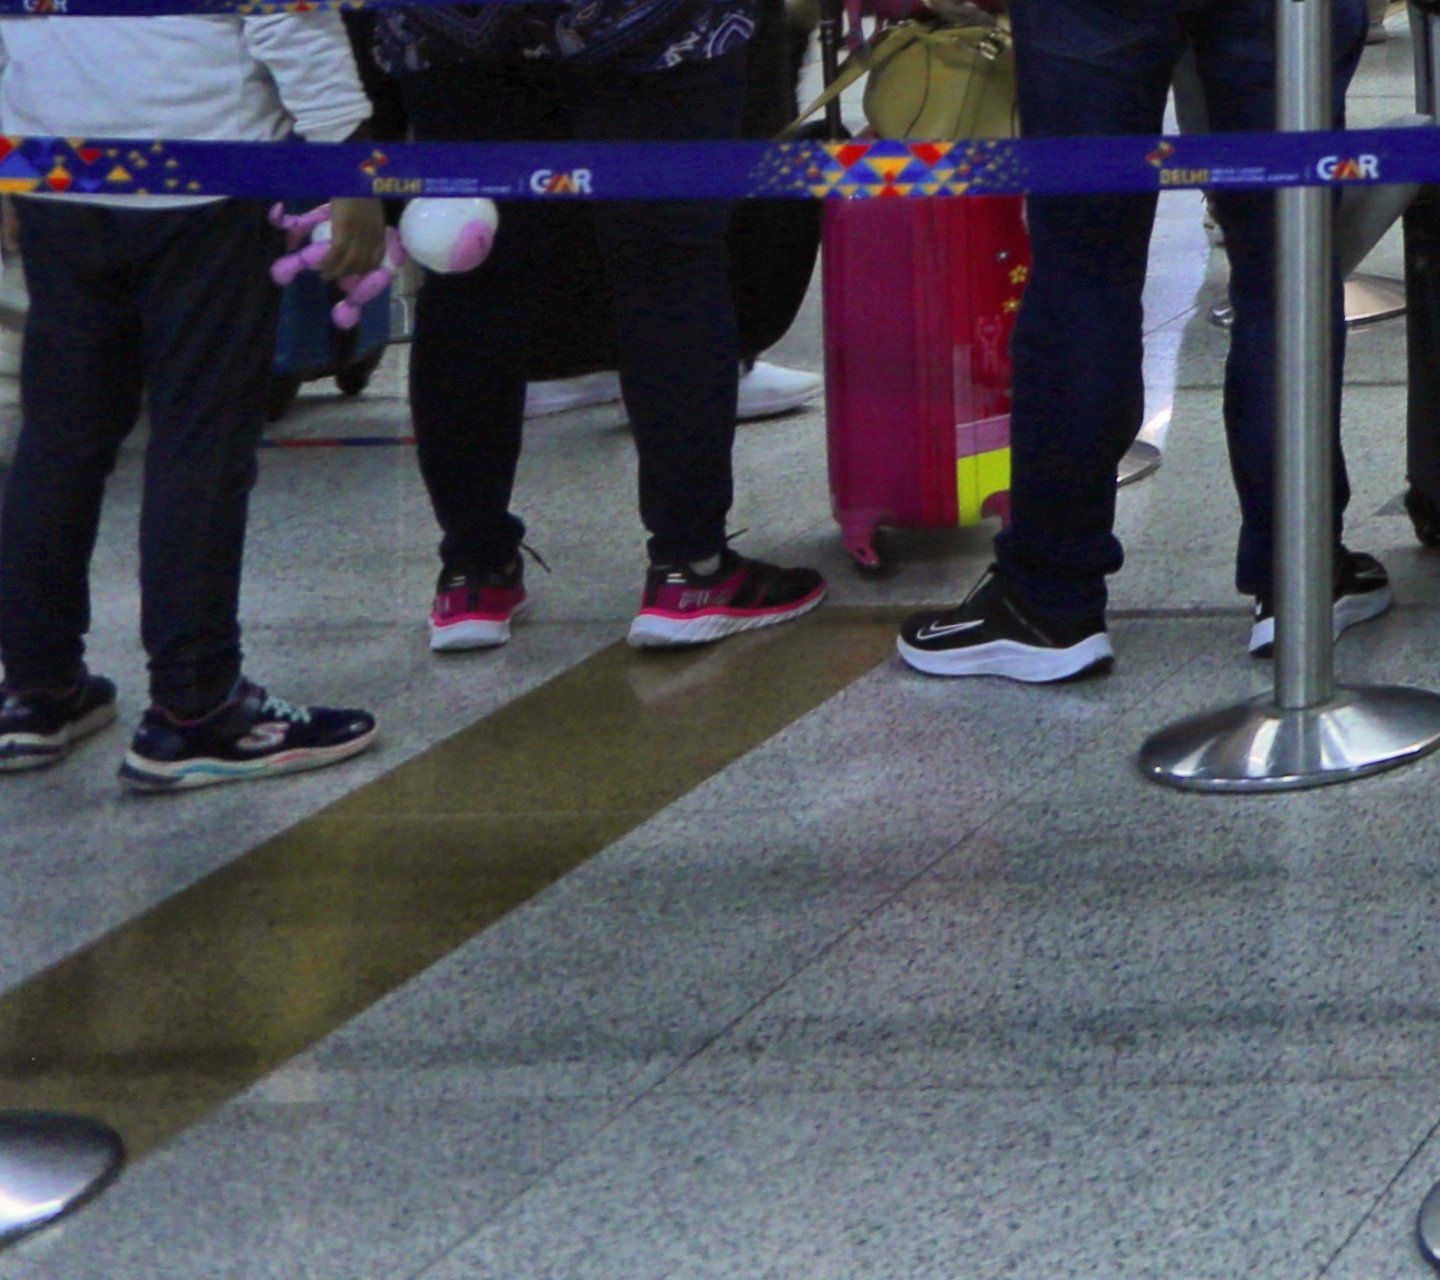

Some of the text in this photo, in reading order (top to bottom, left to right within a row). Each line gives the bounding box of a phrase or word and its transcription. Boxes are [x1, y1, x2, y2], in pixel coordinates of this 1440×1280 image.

[530, 169, 592, 193] GMR
[1160, 169, 1208, 184] DELHI
[1317, 154, 1378, 180] GMR
